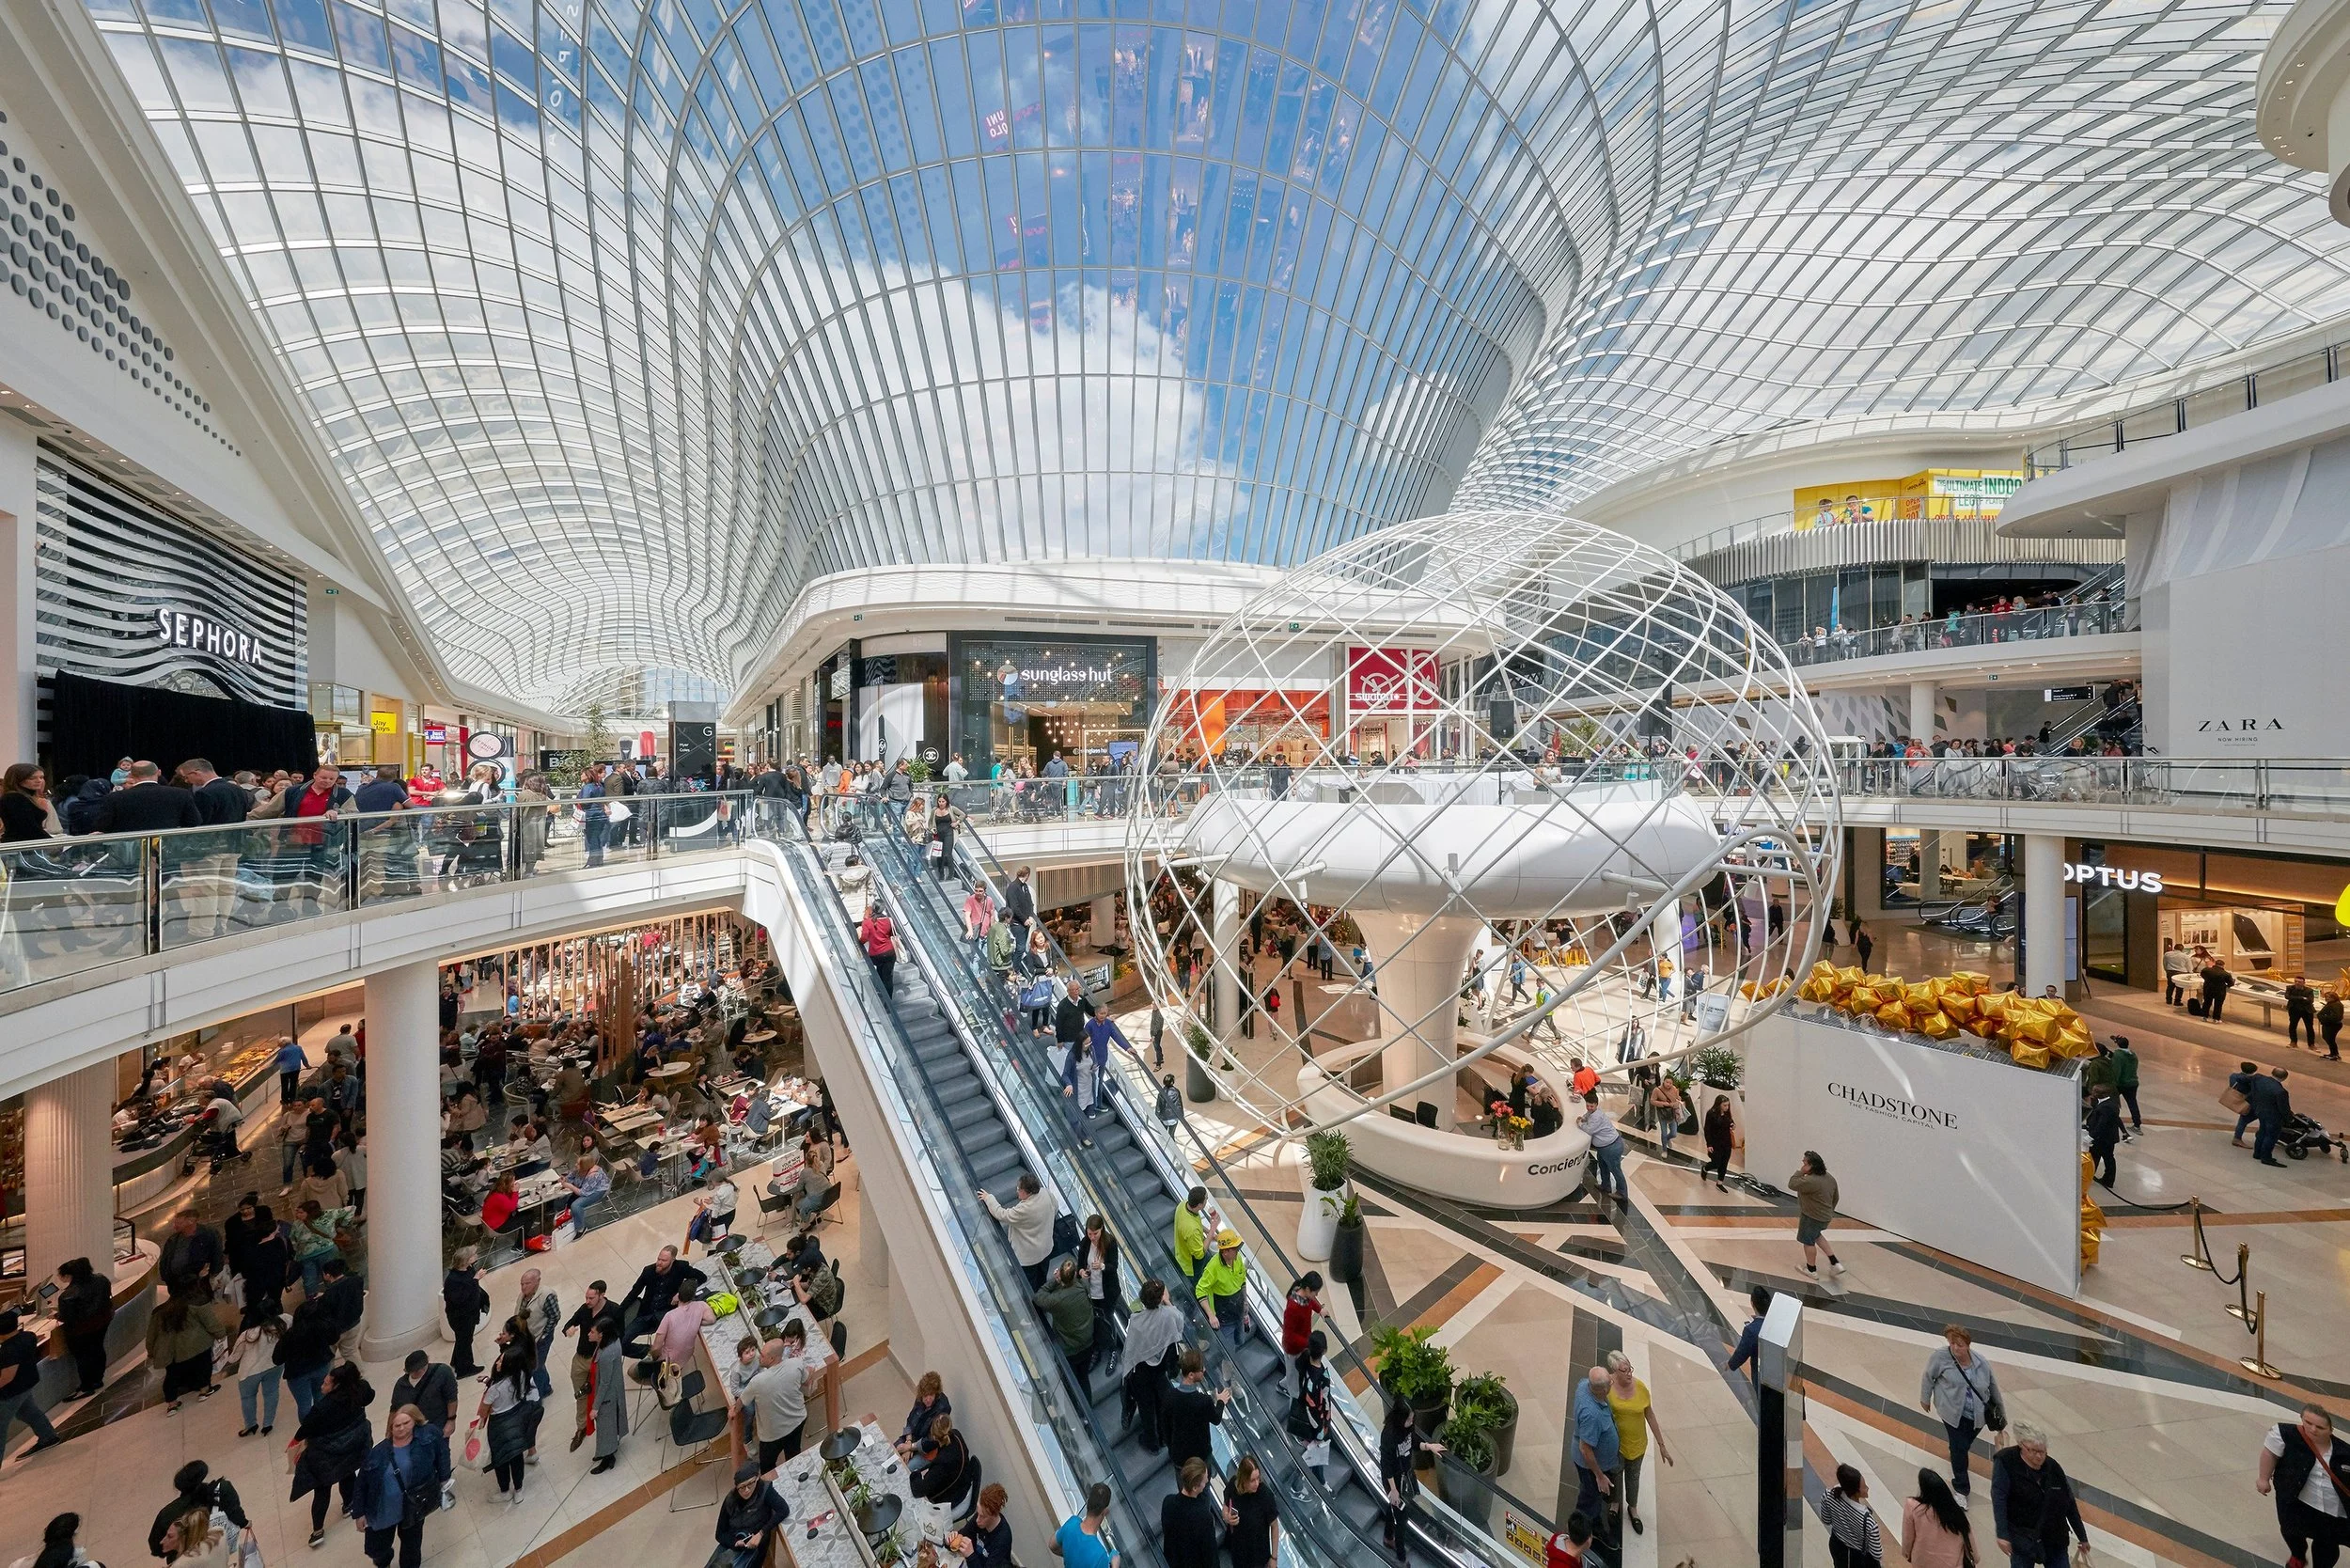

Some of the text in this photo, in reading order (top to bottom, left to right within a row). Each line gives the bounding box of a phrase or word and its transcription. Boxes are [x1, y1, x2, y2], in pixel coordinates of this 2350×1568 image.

[1947, 479, 1982, 492] ULTIMATE
[159, 608, 262, 666] SEPHORA
[1021, 666, 1113, 685] sunglass hut
[702, 726, 713, 737] G
[2198, 717, 2286, 732] ZARA
[1827, 1082, 1958, 1130] CHADSTONE
[1865, 1106, 1899, 1120] FASHION
[1901, 1117, 1935, 1130] CAPITAL
